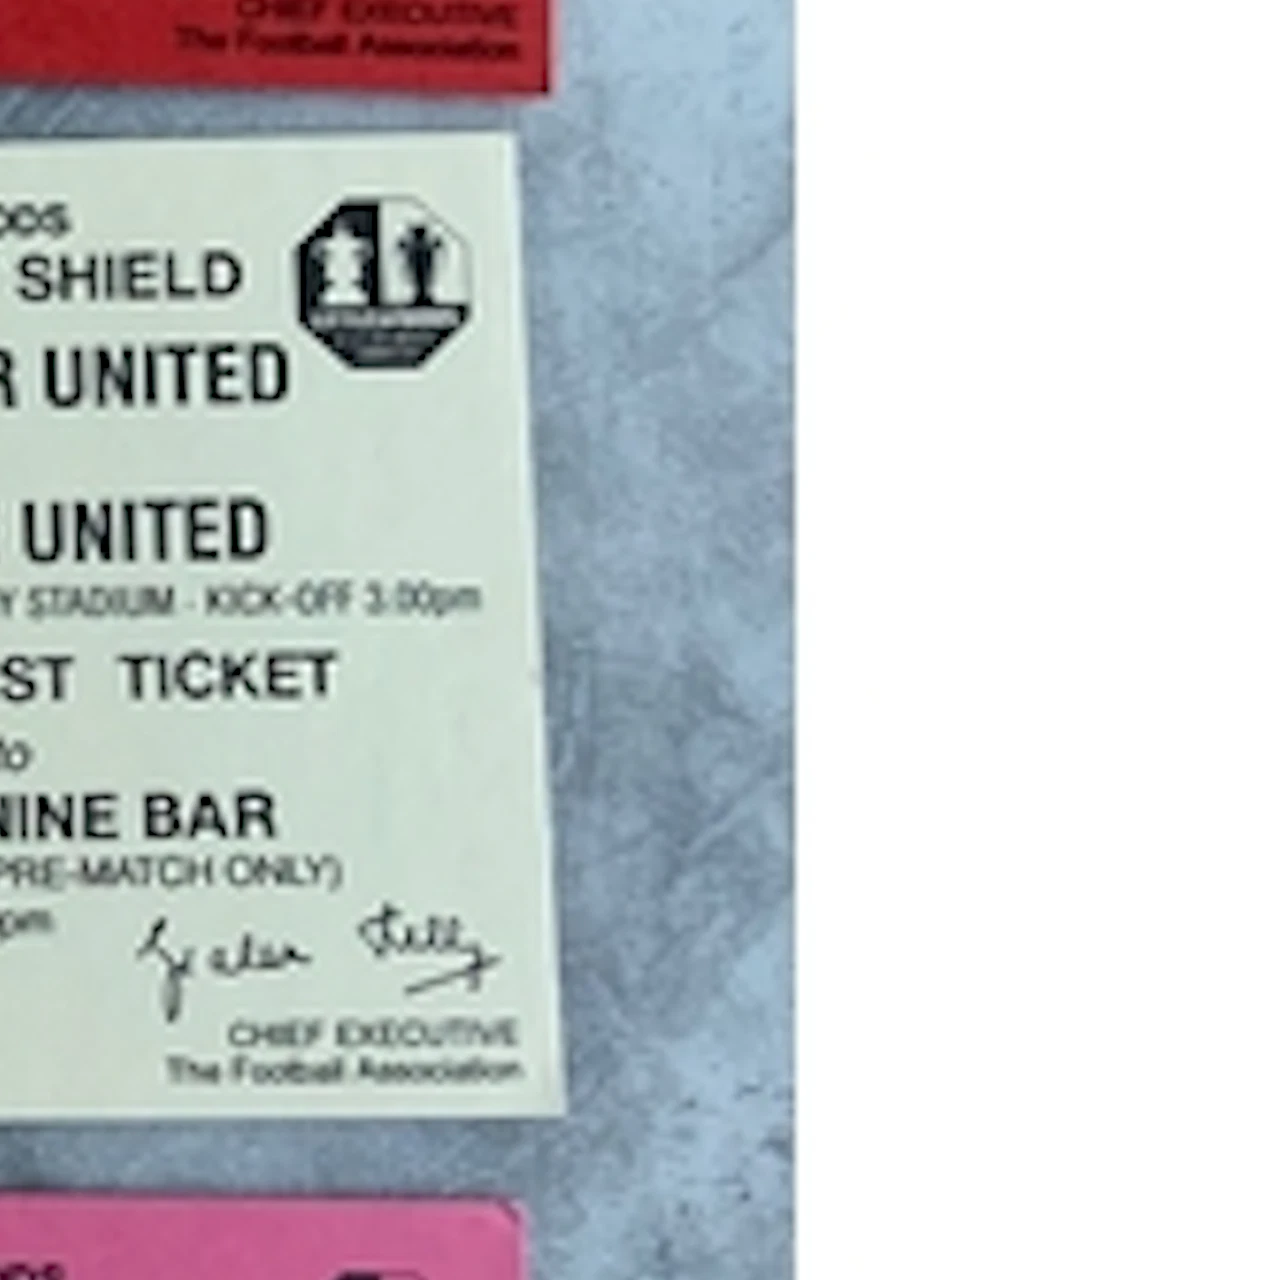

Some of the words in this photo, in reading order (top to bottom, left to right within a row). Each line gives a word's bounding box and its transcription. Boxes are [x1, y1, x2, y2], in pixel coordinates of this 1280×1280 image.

[17, 249, 243, 303] SHIELD
[44, 342, 289, 409] UNITED
[22, 497, 267, 564] UNITED
[27, 585, 176, 619] STADIUM
[204, 579, 352, 618] KICK-OFF
[365, 579, 482, 619] 3.00pm
[117, 649, 336, 701] TICKET
[143, 791, 275, 840] BAR
[223, 853, 343, 891] ONLY)
[227, 1019, 322, 1049] CHIEF
[334, 1017, 518, 1049] EXECUTIVE
[166, 1055, 222, 1085] The
[230, 1054, 345, 1085] Football
[356, 1056, 523, 1085] Association
